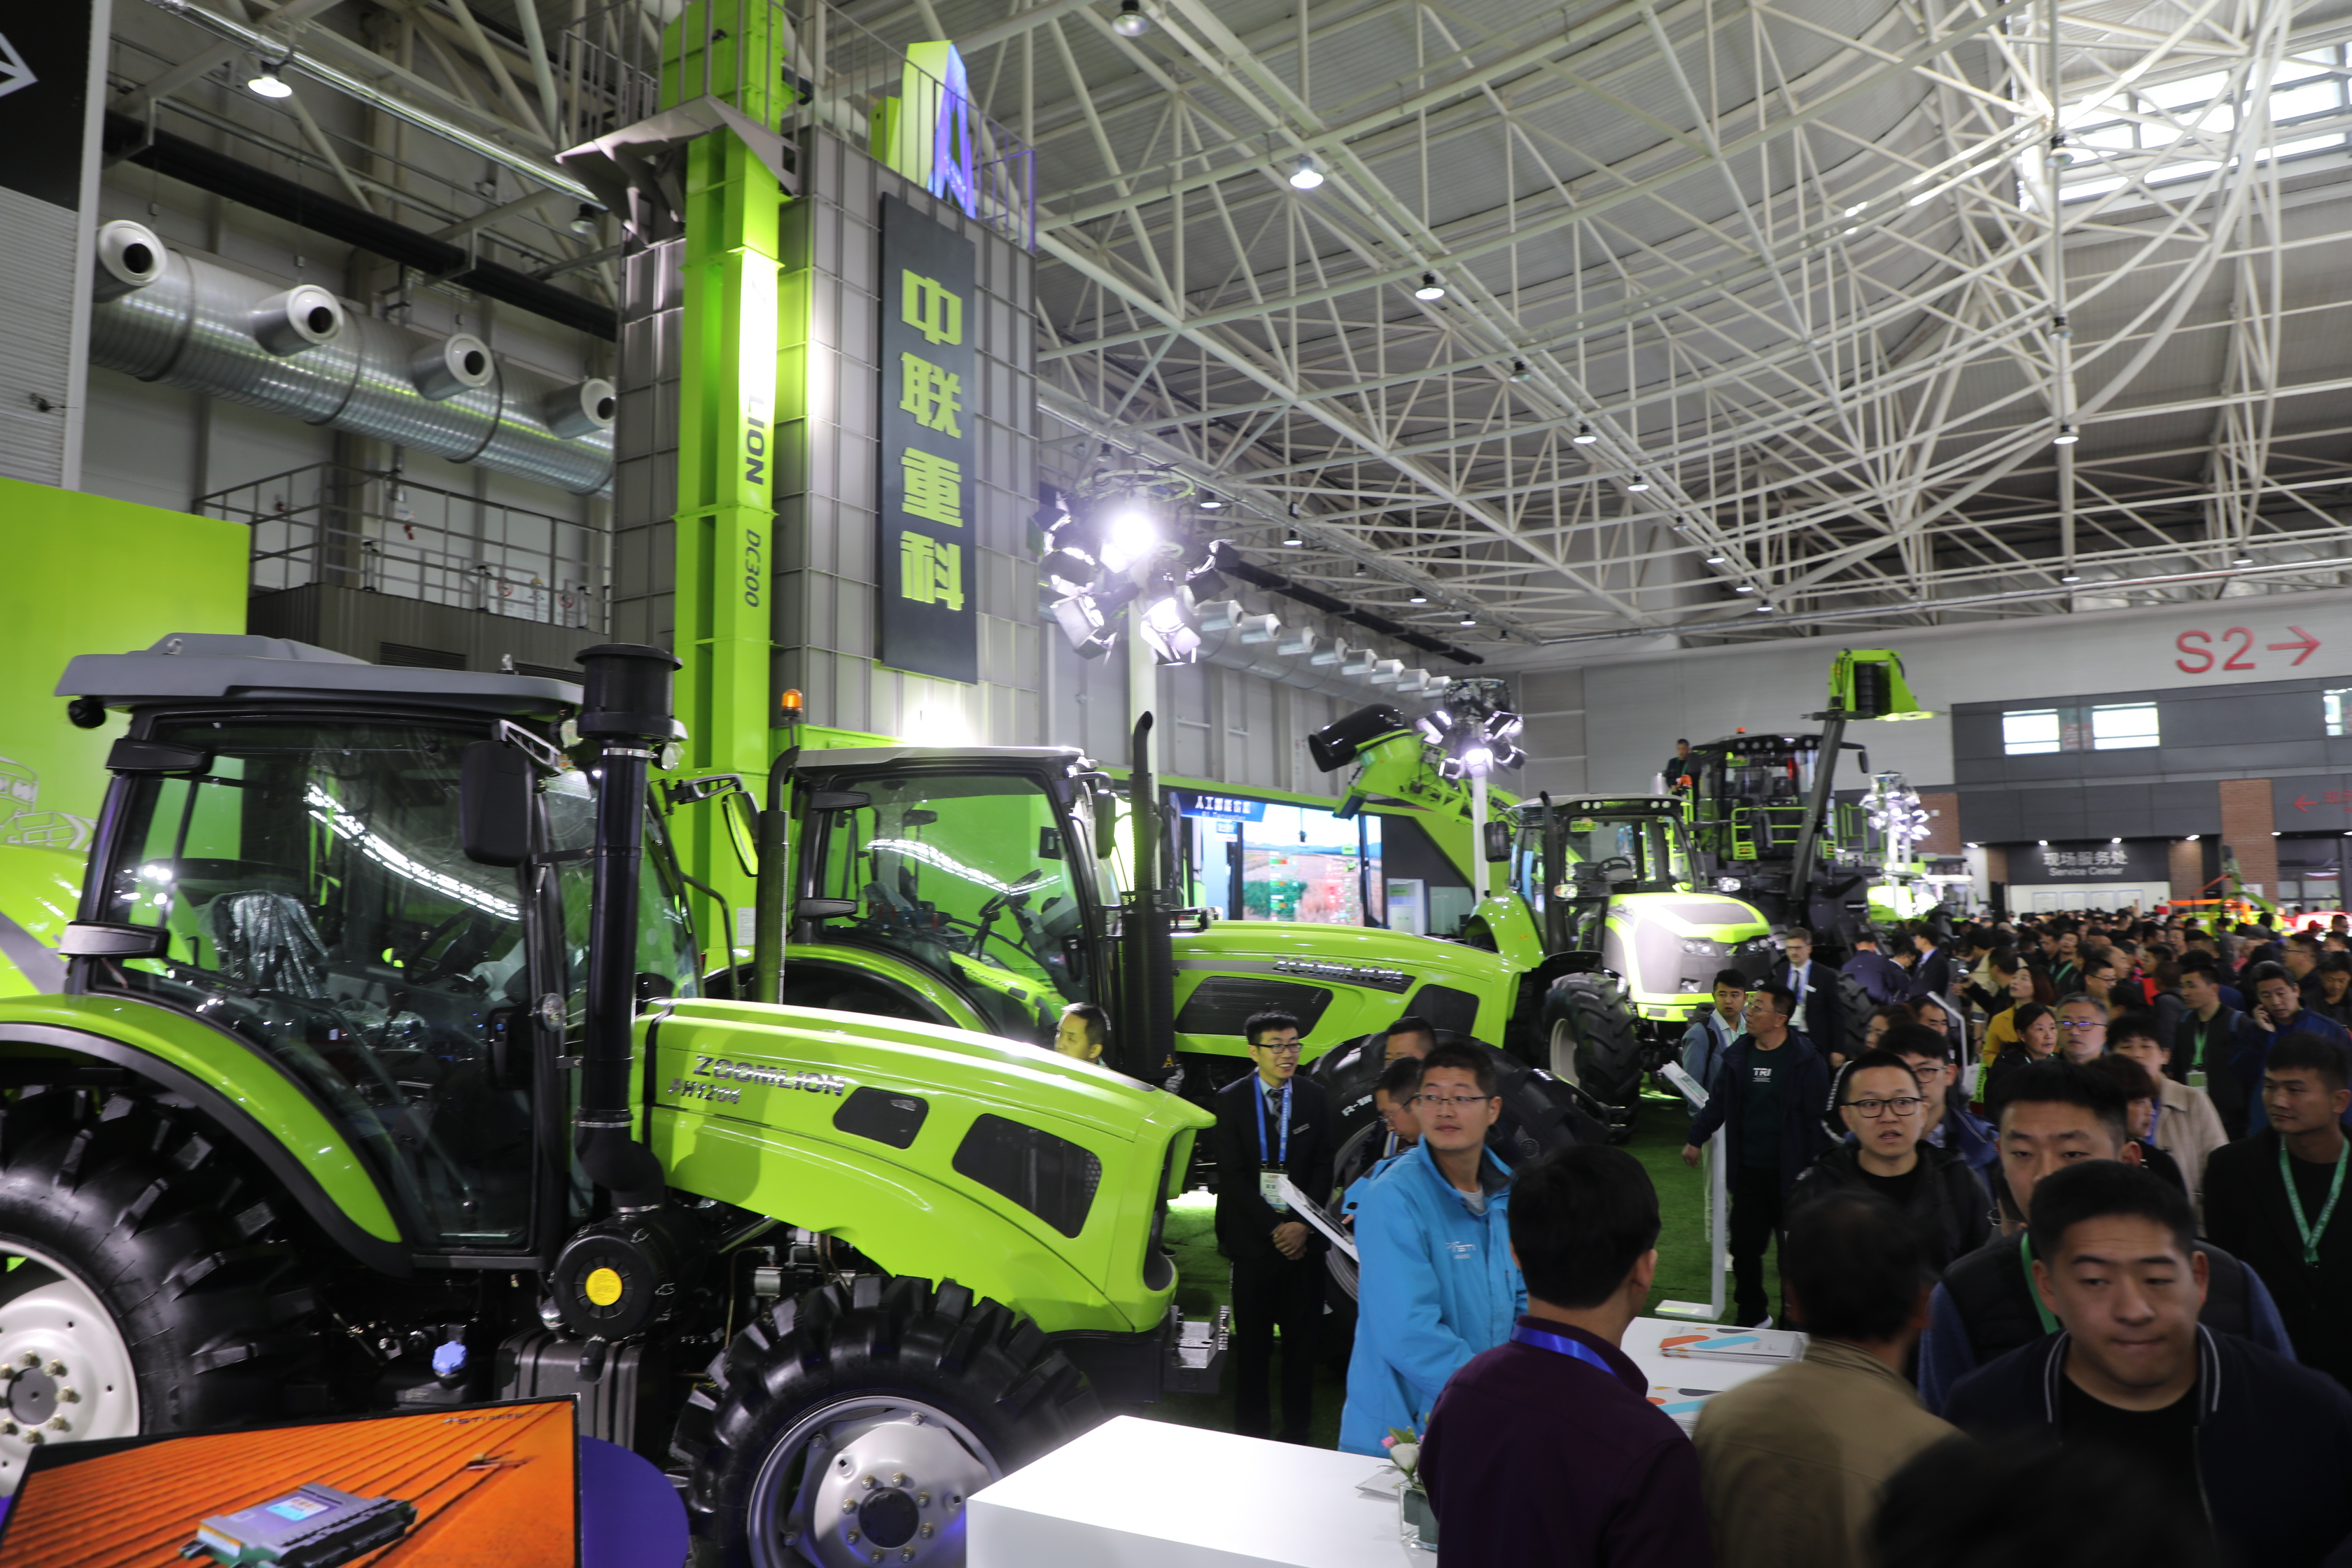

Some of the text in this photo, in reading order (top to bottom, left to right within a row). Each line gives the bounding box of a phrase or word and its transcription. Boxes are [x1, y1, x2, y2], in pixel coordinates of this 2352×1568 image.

[899, 269, 964, 610] 中联重科
[744, 528, 762, 608] DC300
[2176, 626, 2256, 673] S2
[2043, 850, 2128, 867] 现场服务处
[2048, 867, 2087, 876] Service
[1271, 955, 1403, 983] ZOOMLION
[667, 1078, 742, 1105] PH1204
[692, 1055, 846, 1097] ZOOMLION
